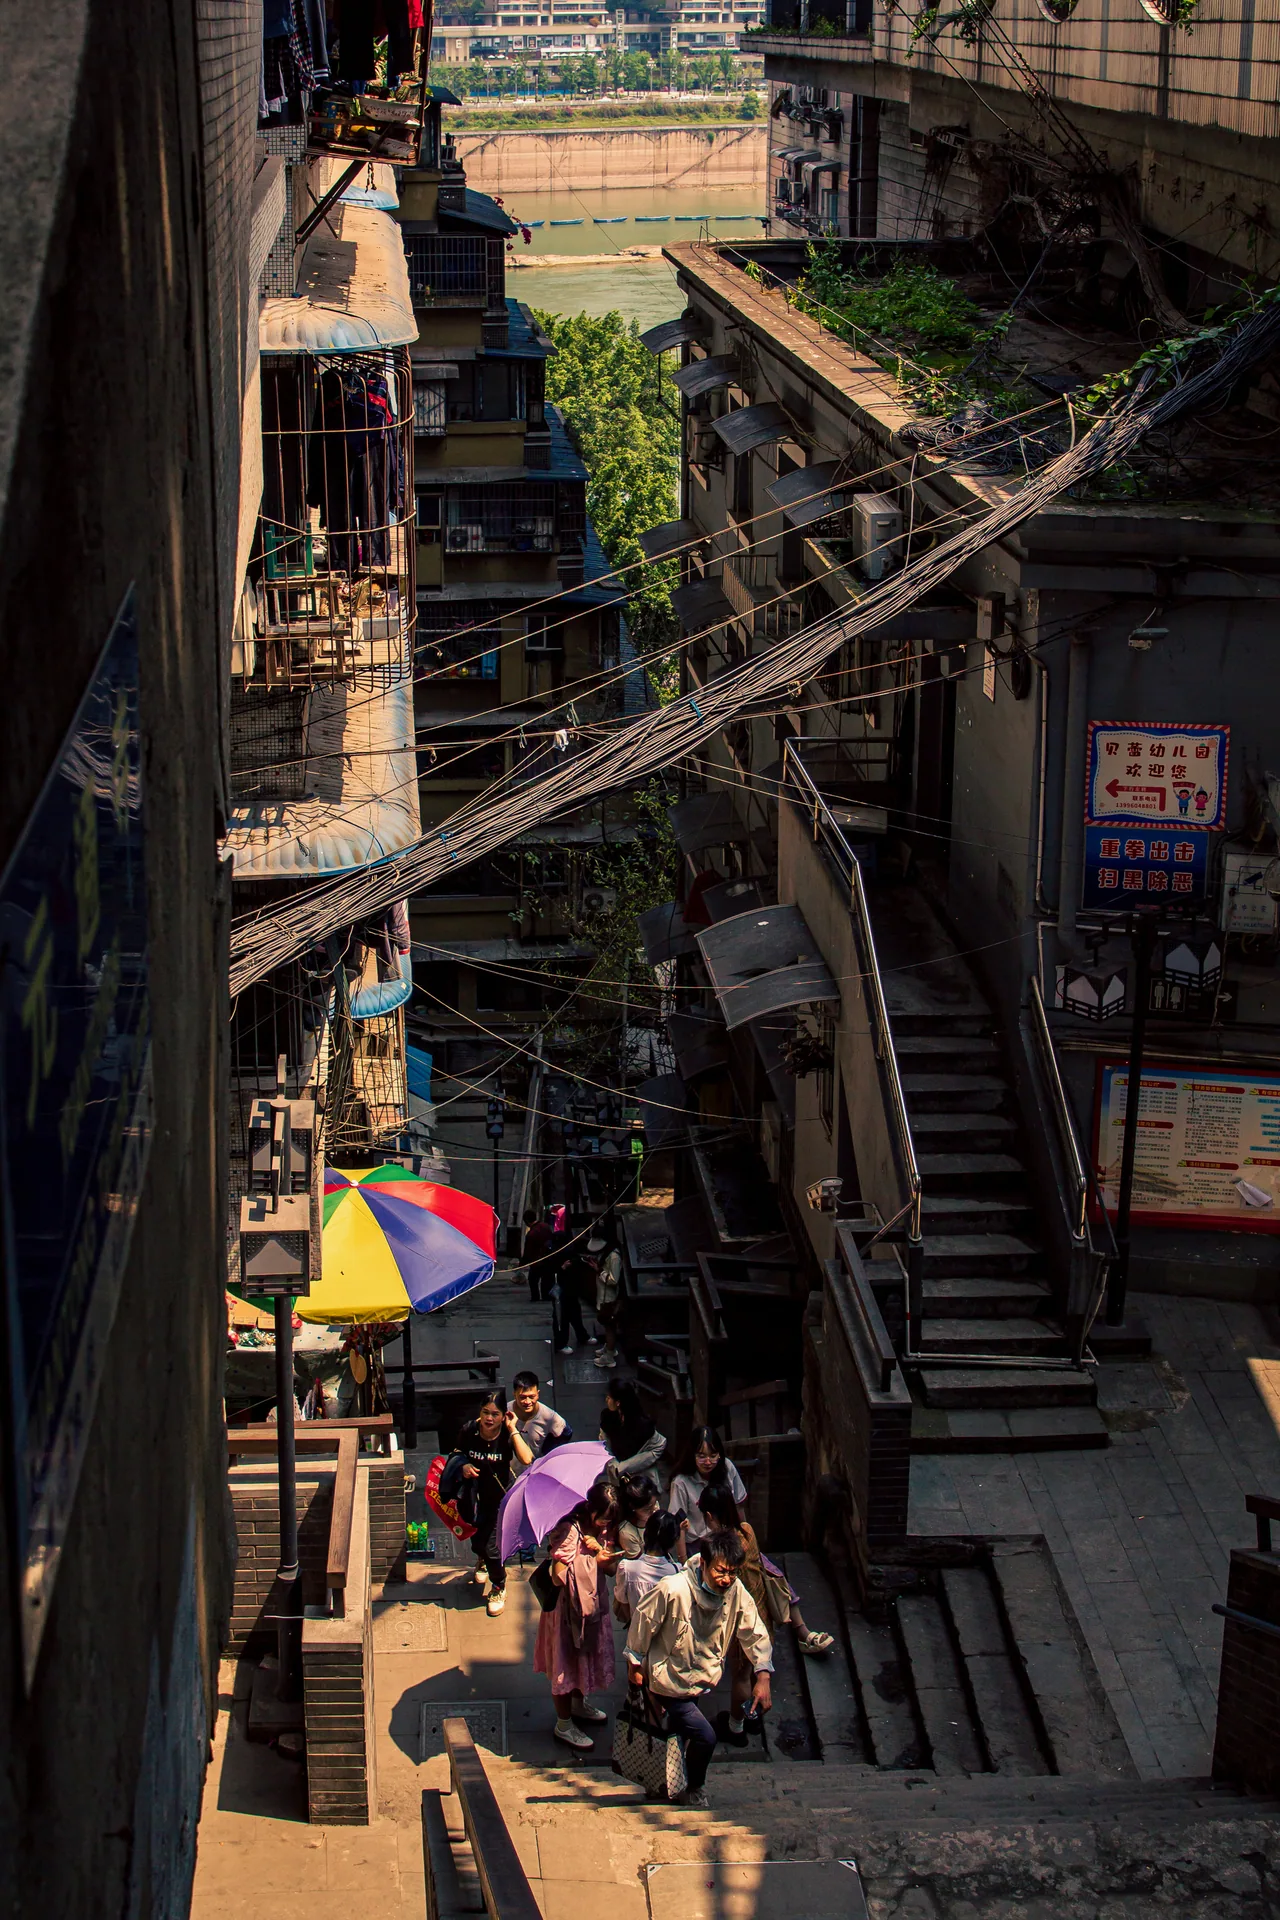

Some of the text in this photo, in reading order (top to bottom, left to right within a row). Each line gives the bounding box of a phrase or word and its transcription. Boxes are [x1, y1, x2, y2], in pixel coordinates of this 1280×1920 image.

[1105, 741, 1211, 759] 贝蕾幼儿园
[1125, 763, 1188, 780] 欢迎您
[1099, 838, 1195, 863] 重拳出击
[1098, 867, 1194, 893] 扫黑除恶
